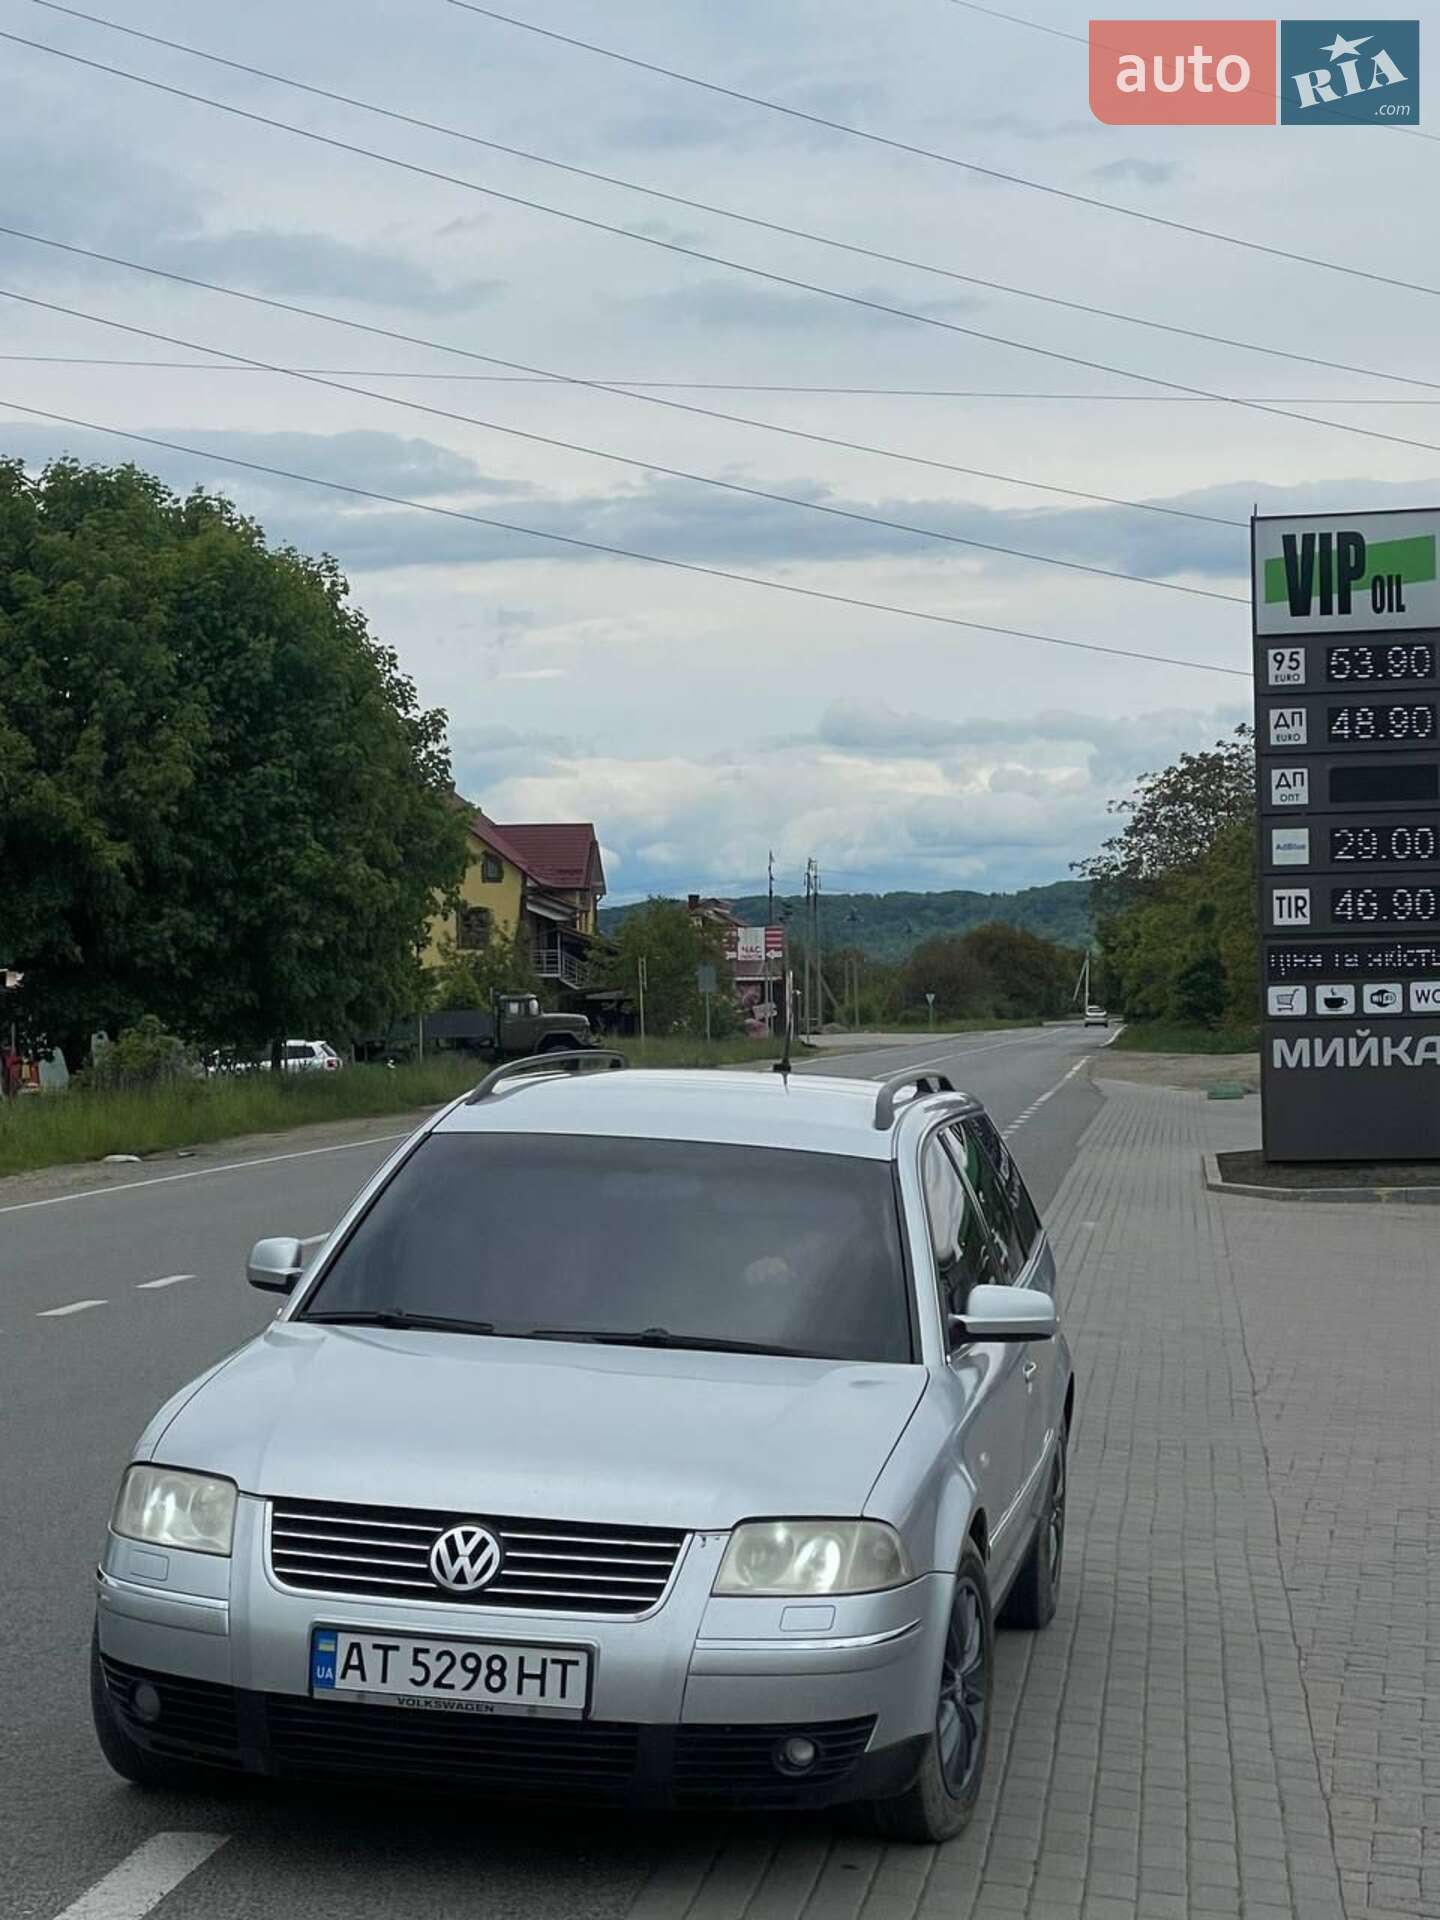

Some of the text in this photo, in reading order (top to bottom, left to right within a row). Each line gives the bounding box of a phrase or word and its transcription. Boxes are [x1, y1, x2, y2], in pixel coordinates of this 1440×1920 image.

[1281, 531, 1406, 617] VIP OIL
[1272, 651, 1302, 672] 95
[1274, 673, 1301, 682] EURO
[1331, 706, 1433, 739] 48.90
[1276, 732, 1301, 742] EURO
[1333, 828, 1435, 860] 29.00
[1275, 895, 1308, 919] TIR
[1334, 889, 1436, 921] 46.90
[1272, 1027, 1440, 1069] МИЙКА
[316, 1667, 334, 1680] UA
[340, 1642, 580, 1699] AT 5298 HT
[396, 1696, 495, 1714] VOLKSWAGEN
